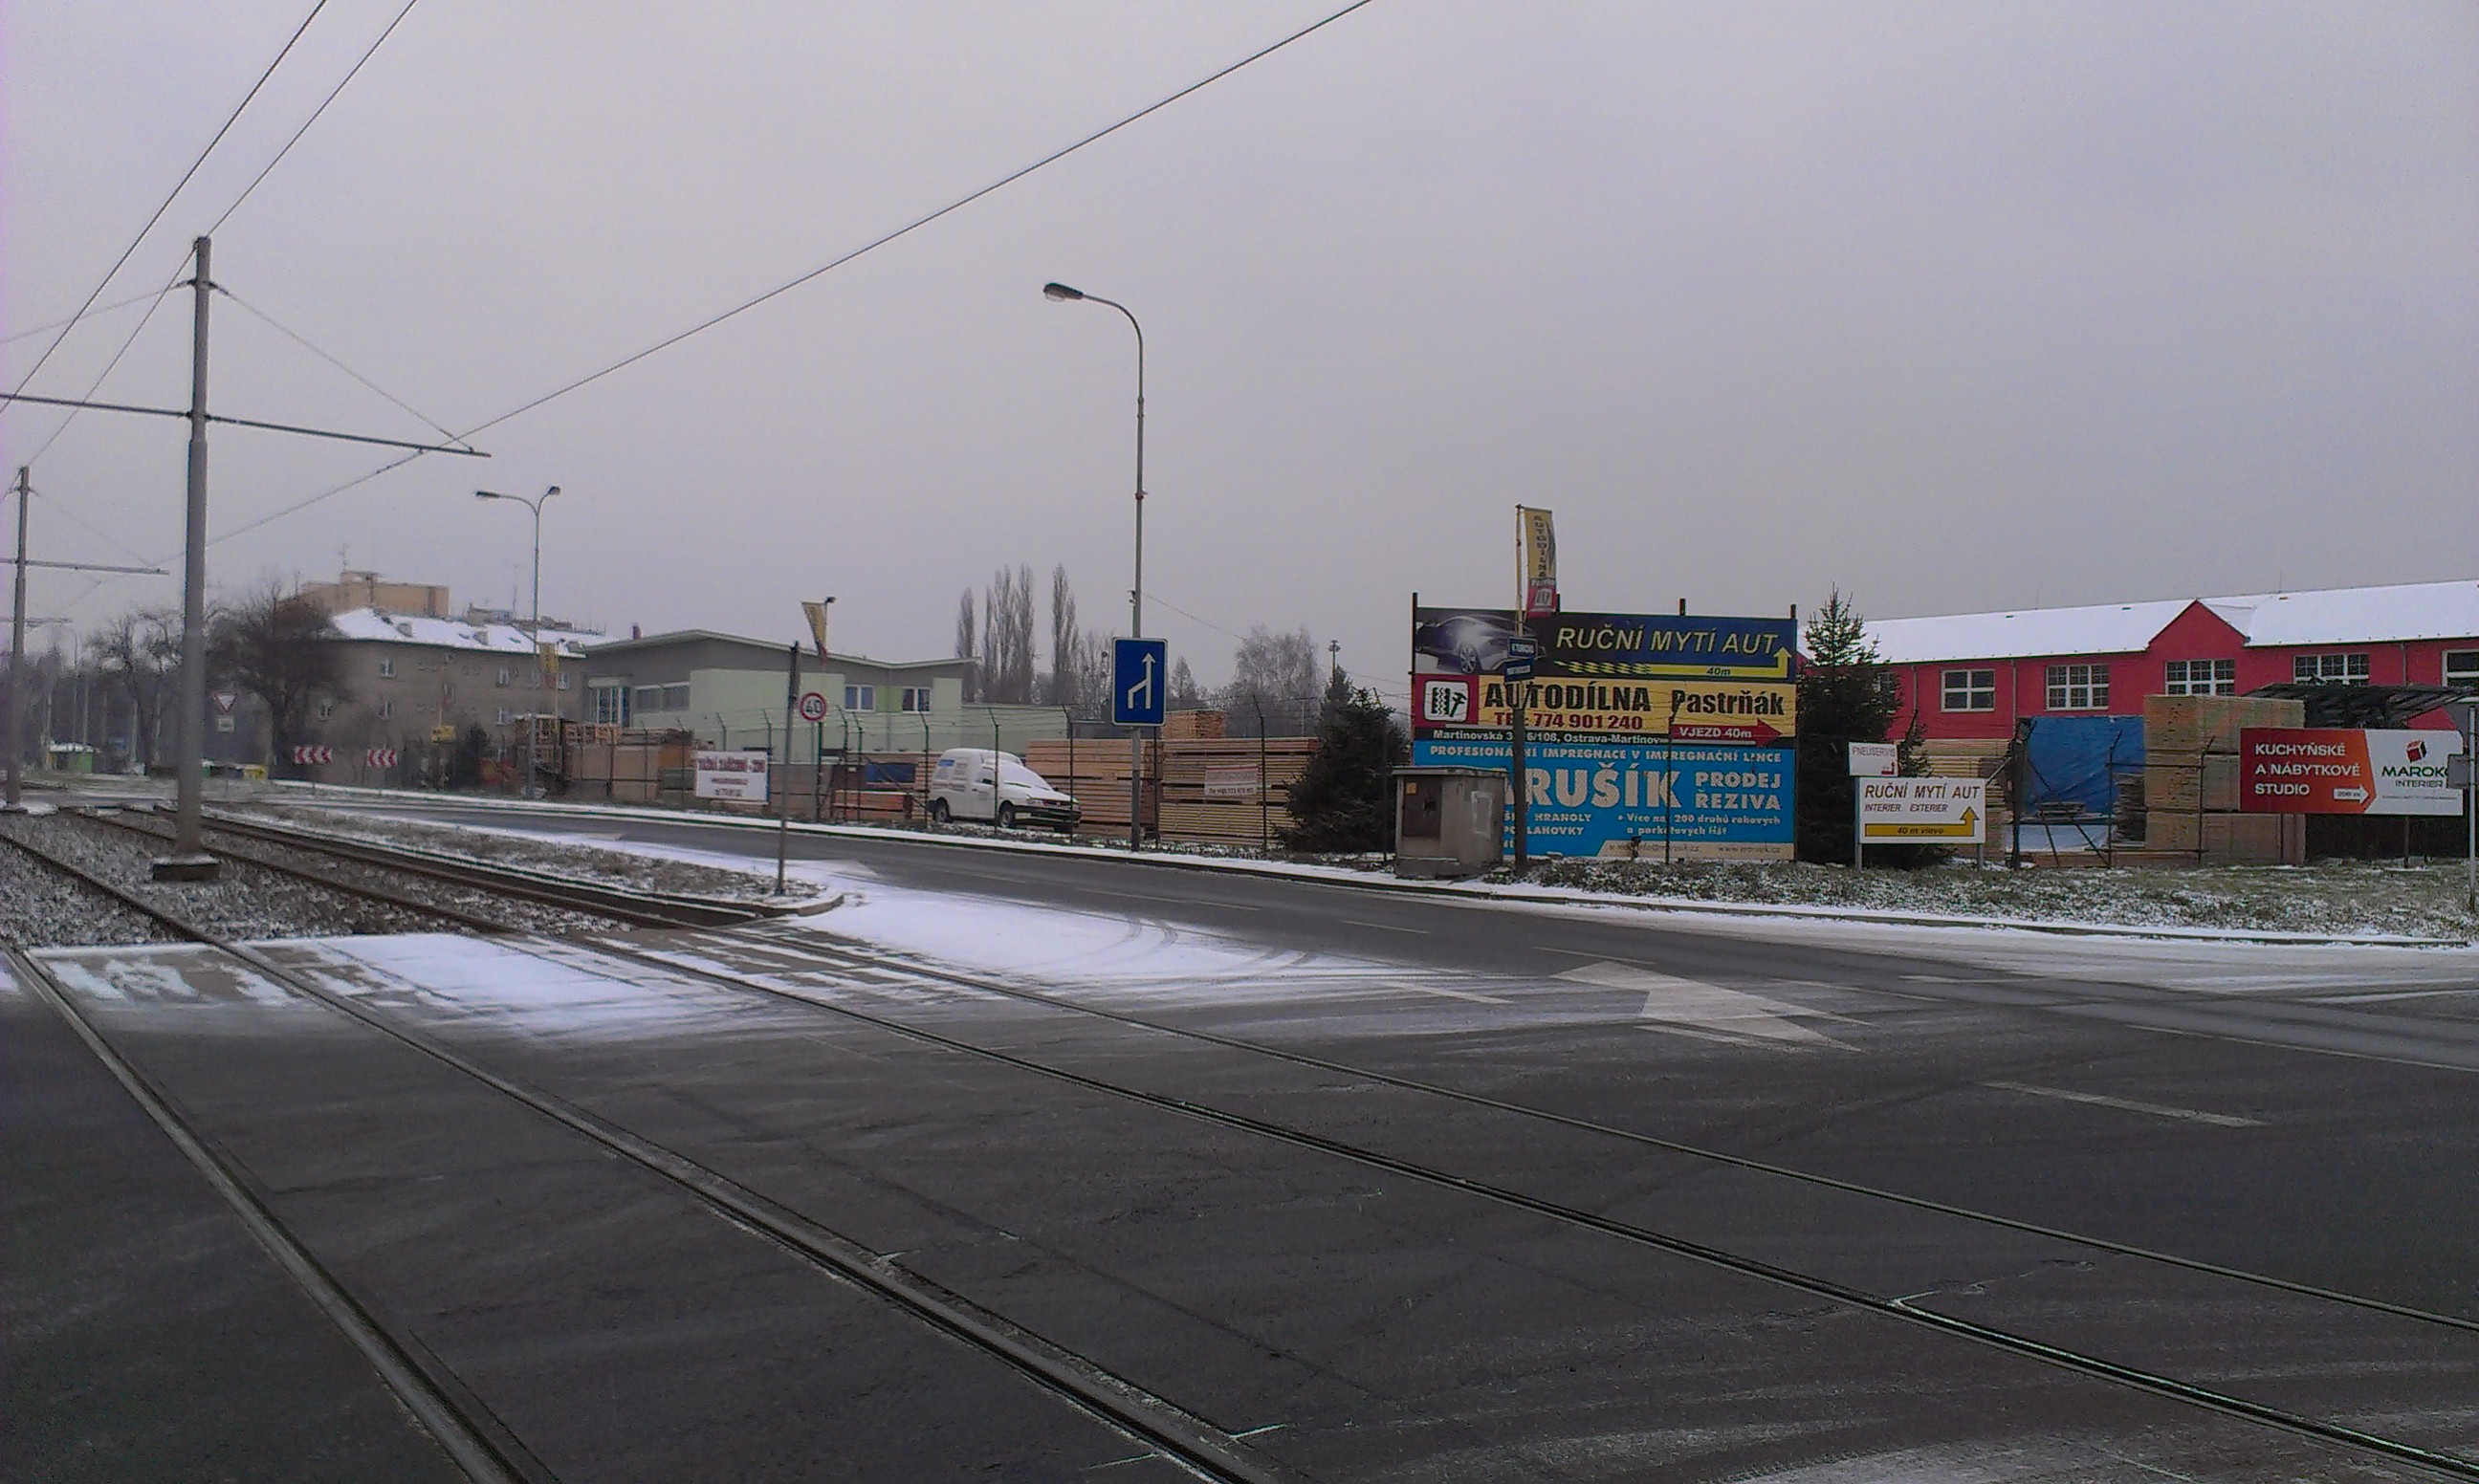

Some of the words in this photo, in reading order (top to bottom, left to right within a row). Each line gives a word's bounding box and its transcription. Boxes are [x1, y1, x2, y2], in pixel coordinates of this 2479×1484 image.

[1556, 623, 1645, 651] RUČNÍ
[1650, 627, 1717, 654] MYTÍ
[1722, 633, 1778, 655] AUT
[1706, 666, 1731, 677] 40m
[1484, 680, 1652, 712] AUTODÍLNA
[1672, 689, 1785, 716] Pastrňák
[805, 699, 823, 713] 40
[1533, 713, 1565, 727] 774
[1569, 714, 1603, 729] 901
[1608, 715, 1642, 730] 240
[1433, 730, 1503, 740] Martinovská
[1679, 728, 1722, 737] VJEZD
[1724, 729, 1752, 738] 40m
[1543, 748, 1626, 759] IMPREGNACE
[1631, 751, 1640, 759] V
[1646, 750, 1738, 761] IMPREGNAČNÍ
[2255, 742, 2345, 755] KUCHYŇSKÉ
[2255, 764, 2267, 775] A
[2271, 761, 2360, 775] NÁBYTKOVÉ
[1695, 772, 1781, 788] PRODEJ
[1864, 782, 1908, 798] RUČNÍ
[1914, 784, 1947, 798] MYTÍ
[1952, 786, 1980, 799] AUT
[2255, 784, 2310, 795] STUDIO
[1695, 789, 1781, 810] ŘEZIVA
[1535, 814, 1591, 822] HRANOLY
[1627, 813, 1650, 822] Více
